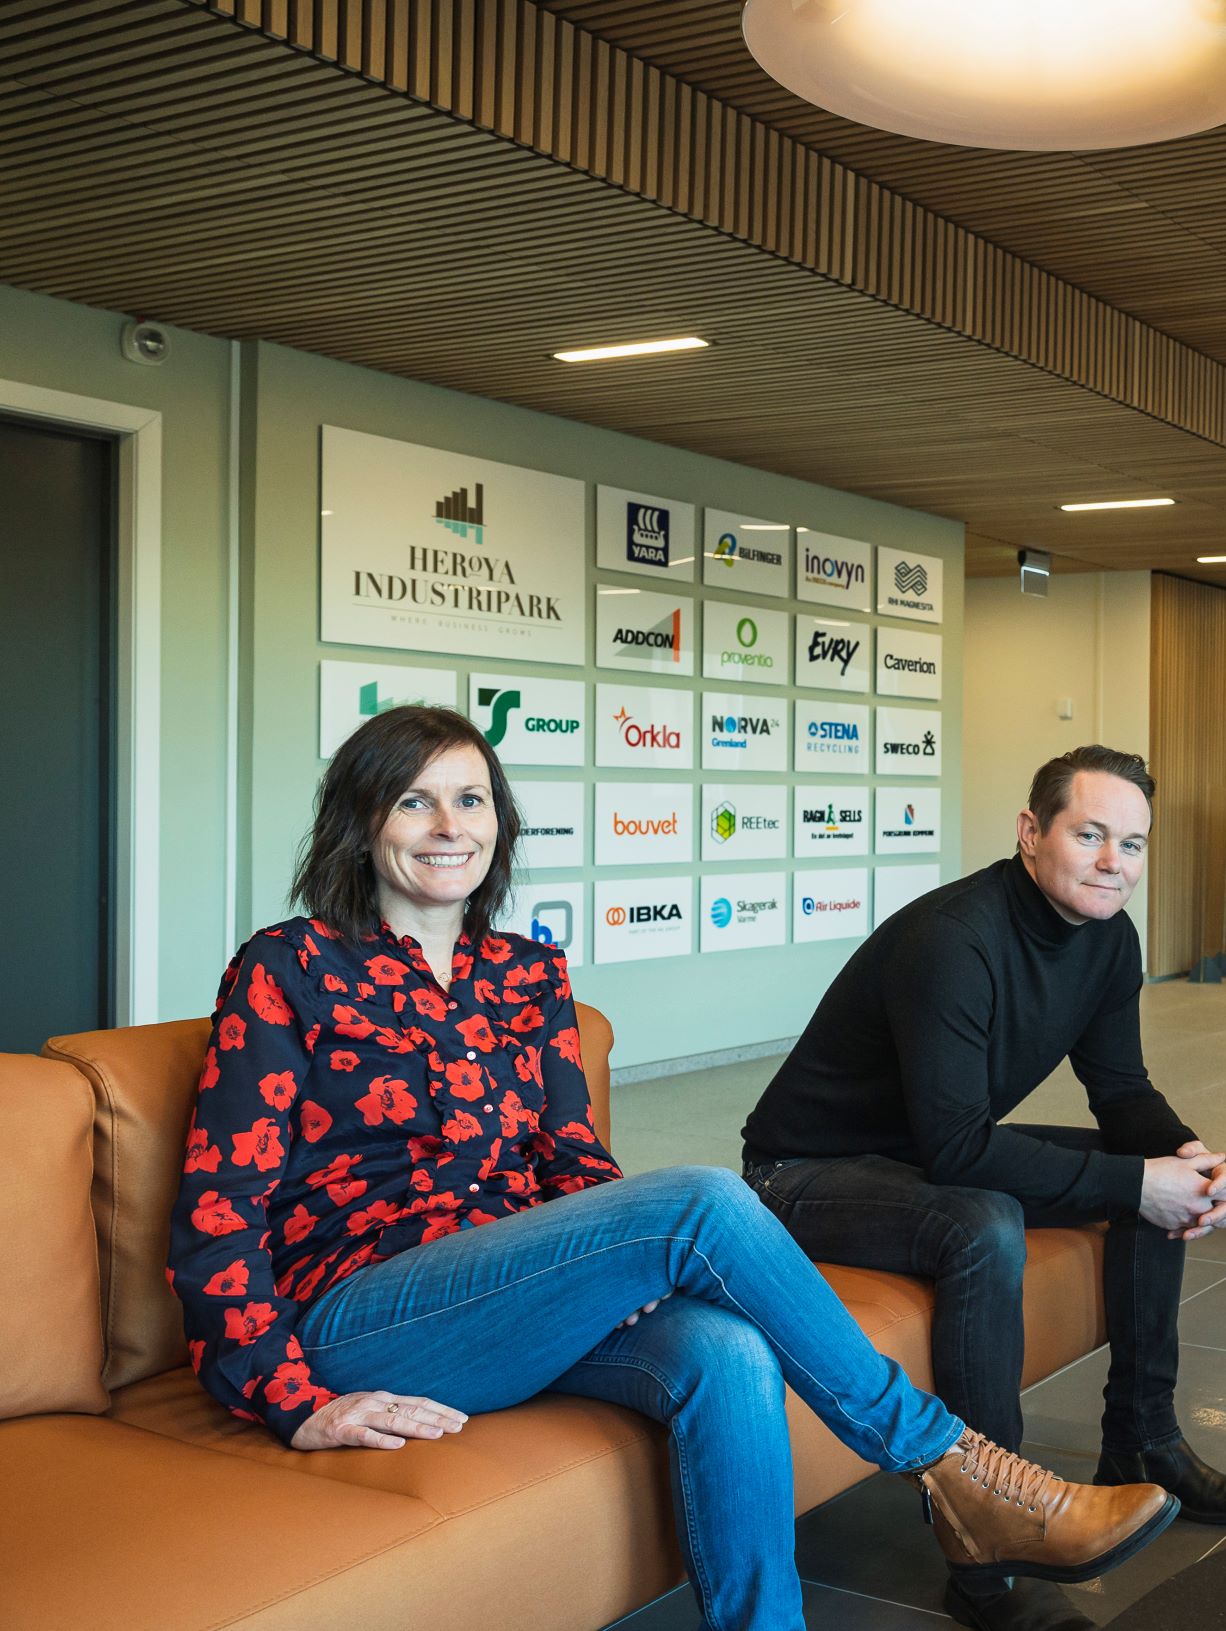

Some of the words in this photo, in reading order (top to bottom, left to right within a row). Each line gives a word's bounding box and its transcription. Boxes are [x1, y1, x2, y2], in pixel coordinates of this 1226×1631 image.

[632, 545, 665, 562] YARA
[739, 547, 783, 566] BILFINGER
[805, 547, 865, 590] inovyn
[352, 570, 563, 622] INDUSTRIPARK
[612, 627, 675, 650] ADDCON
[721, 651, 774, 668] proventia
[884, 653, 937, 675] Caverion
[524, 716, 580, 734] GROUP
[820, 721, 859, 741] STENA
[625, 724, 681, 749] Orkla
[806, 742, 860, 754] RECYCLING
[883, 742, 920, 756] SWECO
[613, 812, 678, 836] bouvet
[741, 816, 780, 830] REEtec
[840, 810, 863, 823] SELLS
[629, 904, 683, 923] IBKA
[736, 899, 778, 914] Skagerak
[816, 901, 827, 912] Air
[829, 899, 861, 912] Liquide
